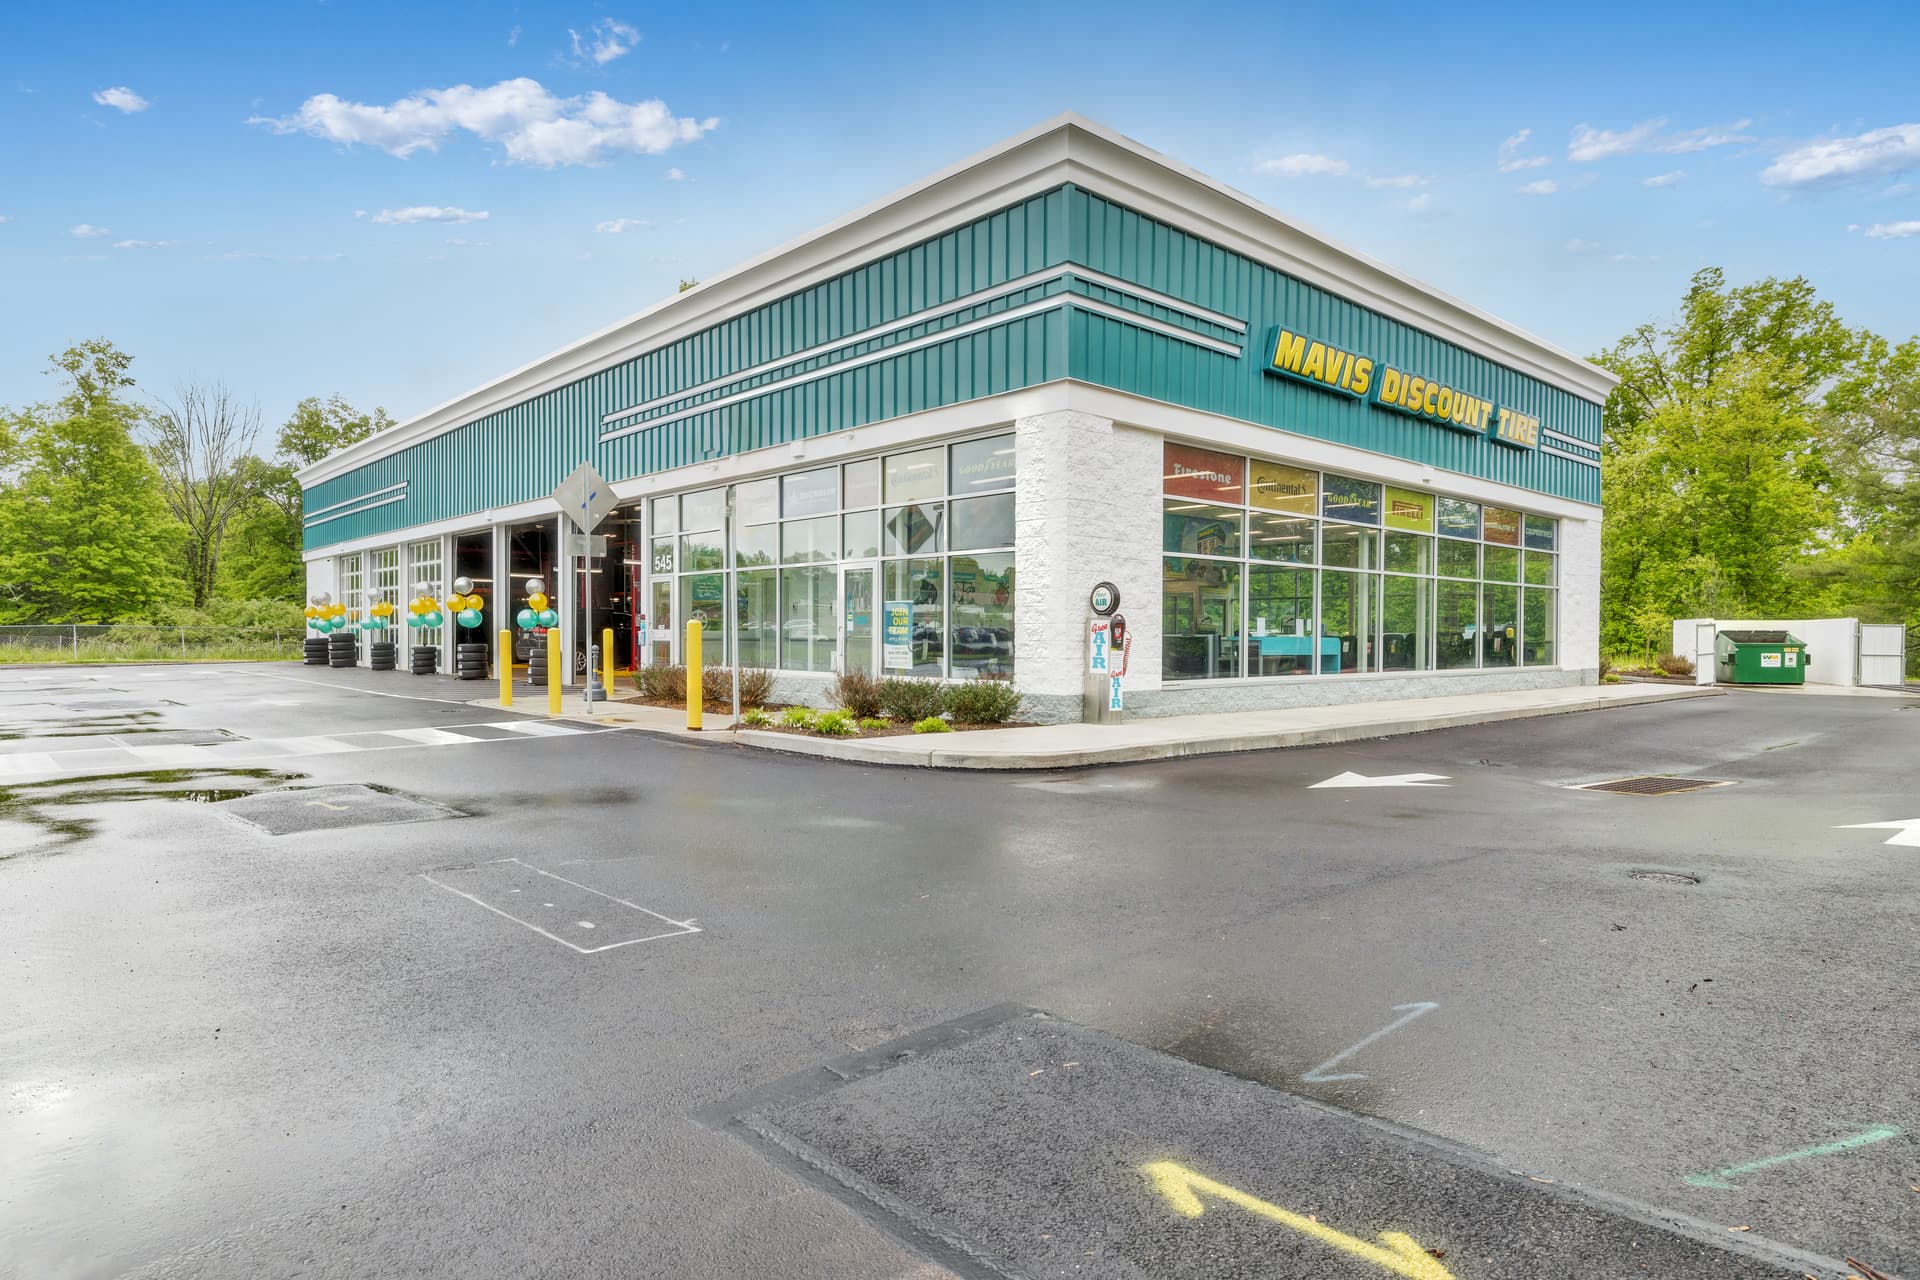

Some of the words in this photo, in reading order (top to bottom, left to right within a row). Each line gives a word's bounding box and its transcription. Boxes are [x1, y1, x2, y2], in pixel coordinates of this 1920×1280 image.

[1274, 330, 1374, 394] MAVIS
[1379, 366, 1493, 431] DISCOUNT
[1499, 406, 1539, 445] TIRE
[1173, 463, 1232, 485] Firestone
[1256, 476, 1301, 496] Continental
[654, 554, 672, 571] 545
[1095, 598, 1107, 606] AIR
[890, 607, 909, 617] JOIN
[888, 626, 909, 635] TEAM
[893, 617, 909, 626] OUR
[1092, 632, 1106, 669] AIR
[1111, 678, 1121, 708] AIR
